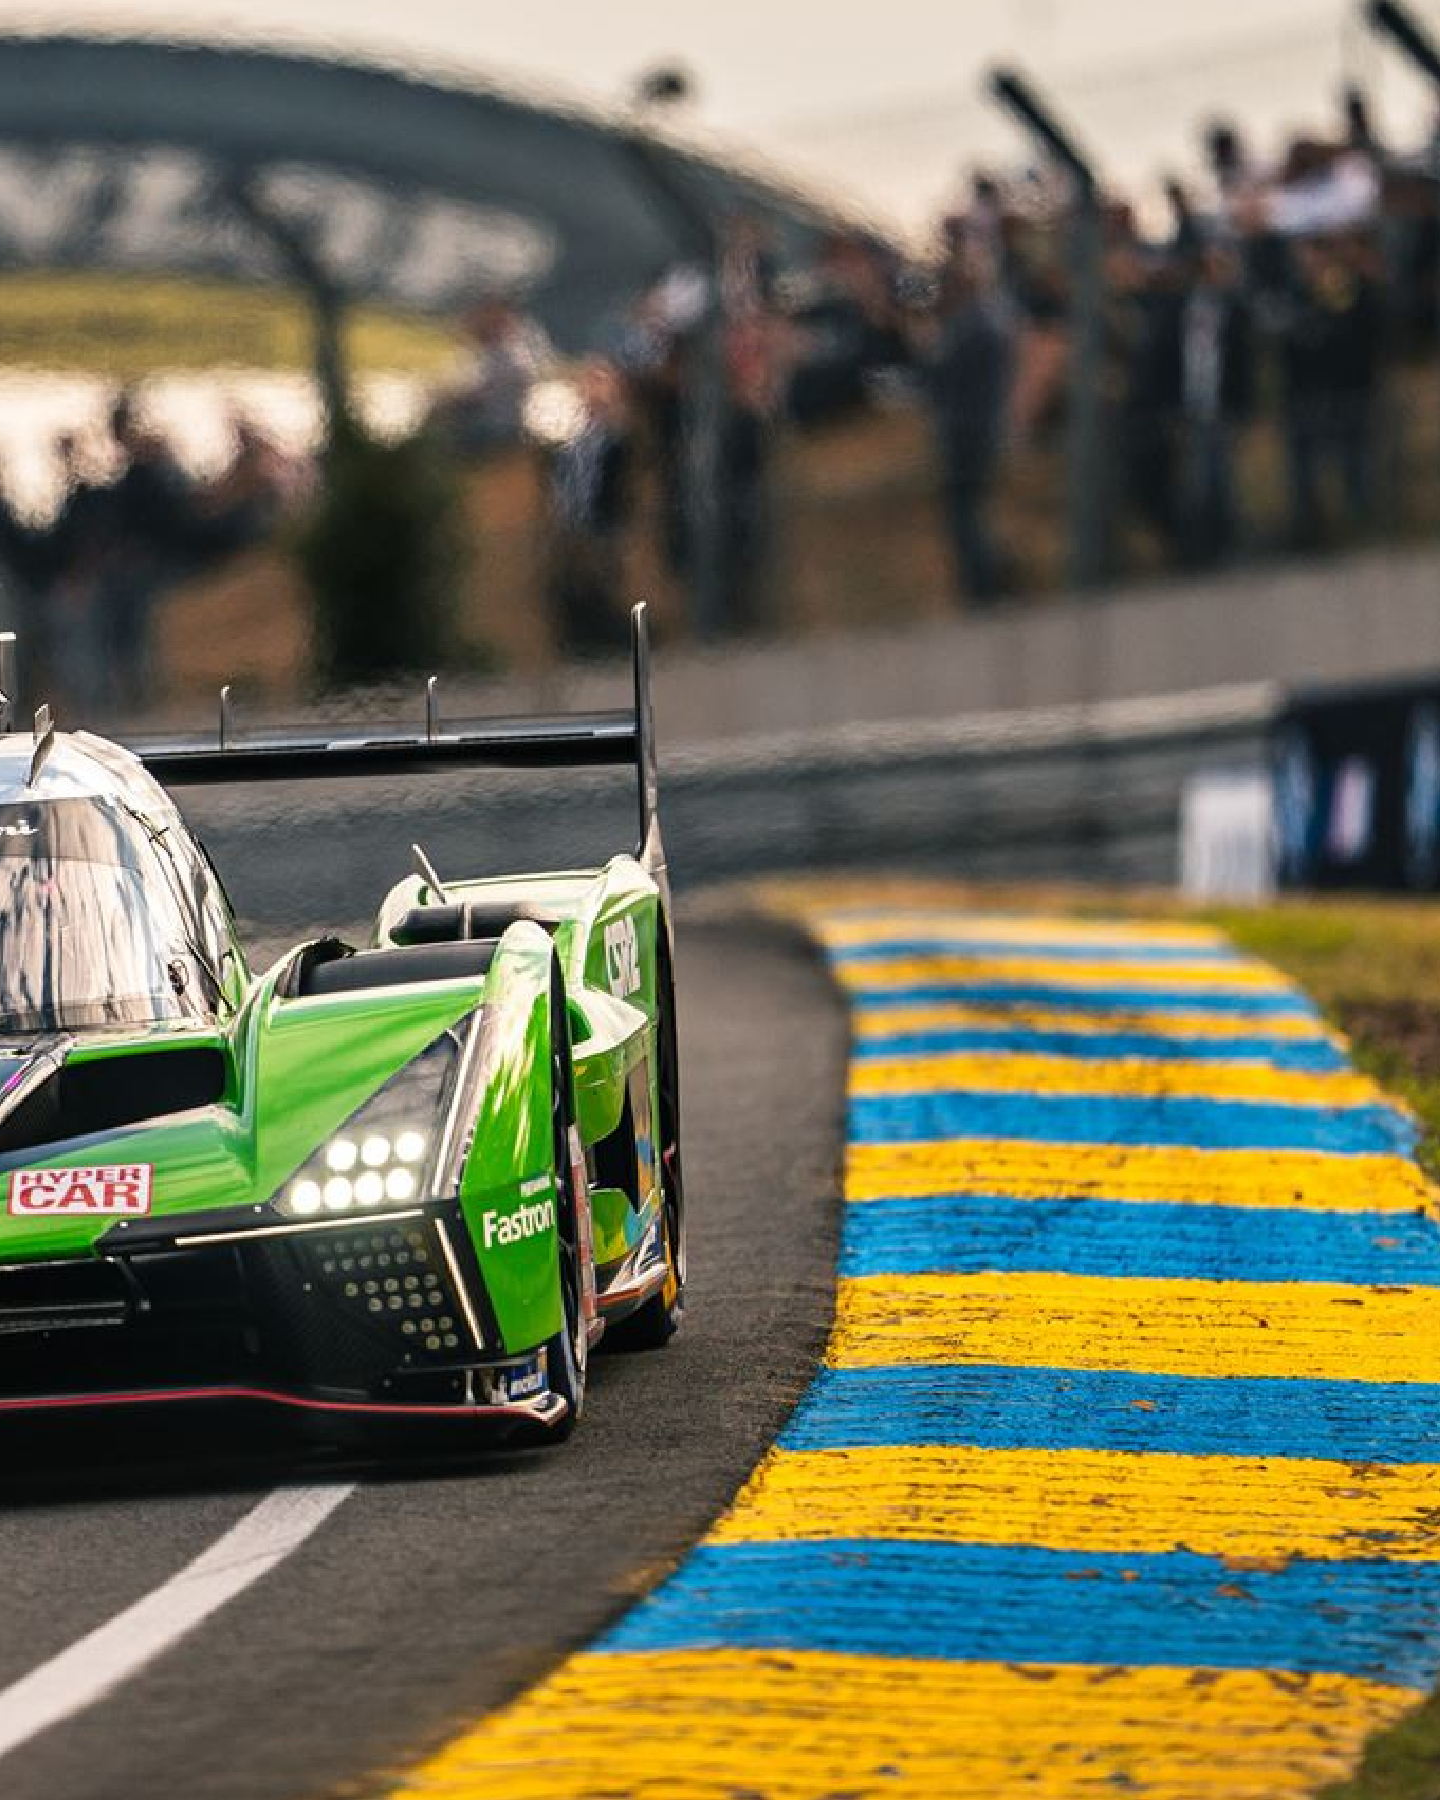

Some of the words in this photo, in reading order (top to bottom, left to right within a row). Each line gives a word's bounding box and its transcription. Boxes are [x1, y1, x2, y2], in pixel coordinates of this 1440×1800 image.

[20, 1168, 141, 1185] HYPER
[20, 1183, 140, 1209] CAR
[482, 1199, 555, 1250] Fastron
